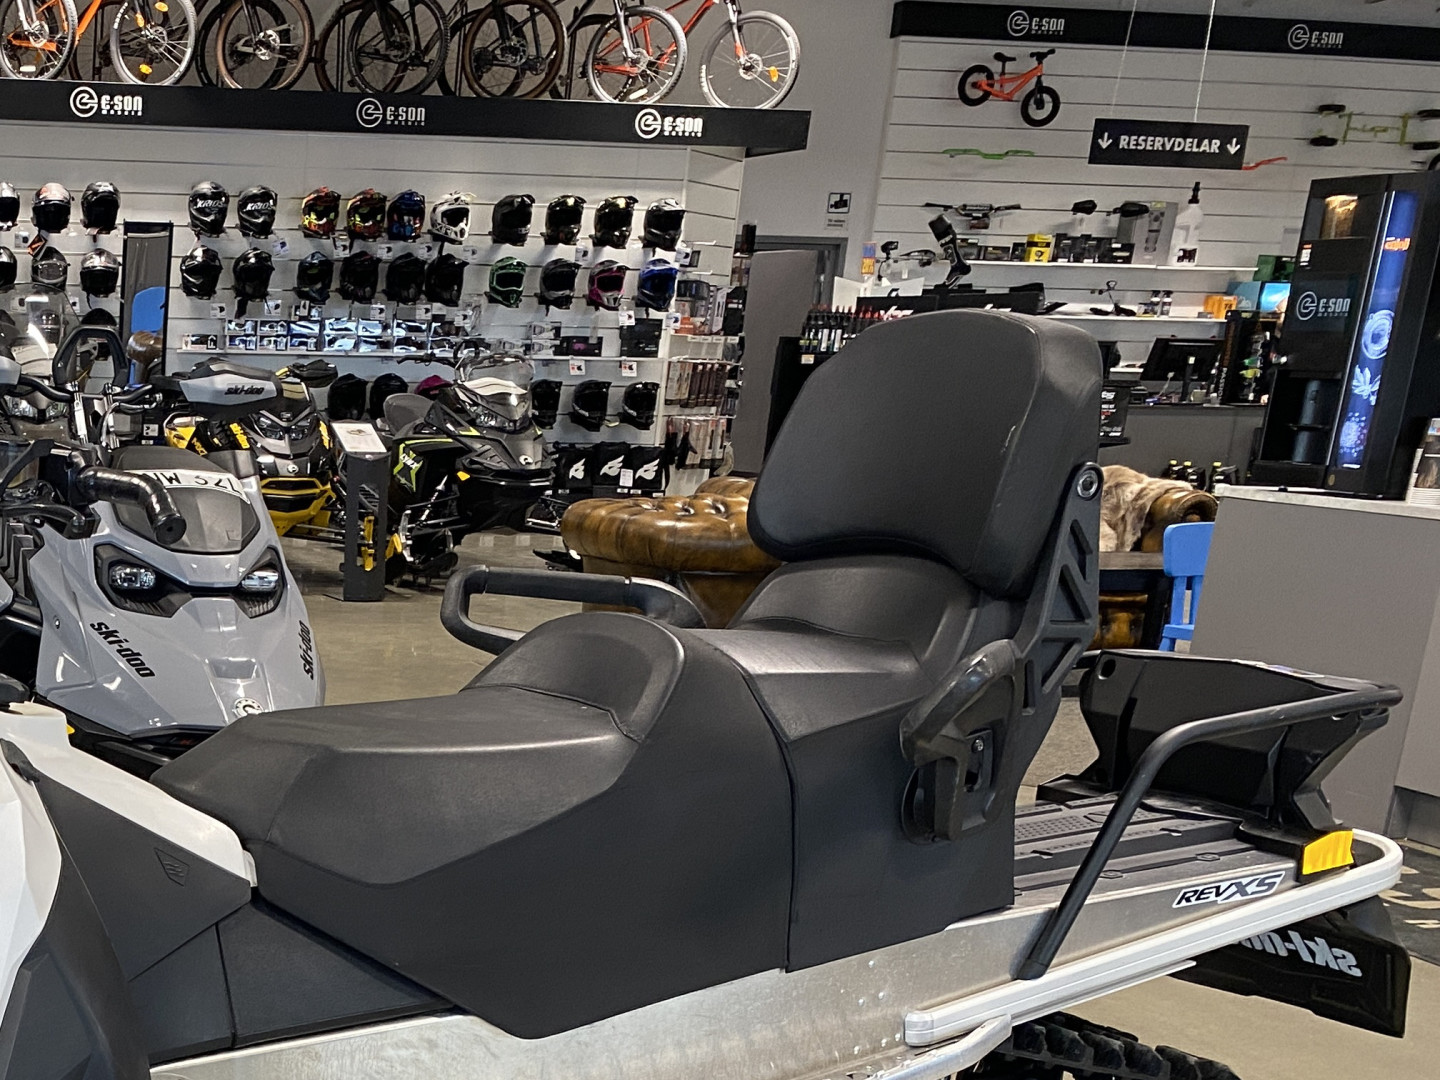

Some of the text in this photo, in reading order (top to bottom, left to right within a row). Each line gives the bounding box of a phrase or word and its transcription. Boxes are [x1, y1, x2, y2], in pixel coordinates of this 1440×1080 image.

[1119, 135, 1221, 153] RESERVDELAR
[89, 620, 156, 678] ski-doo
[298, 619, 316, 681] ski-doo
